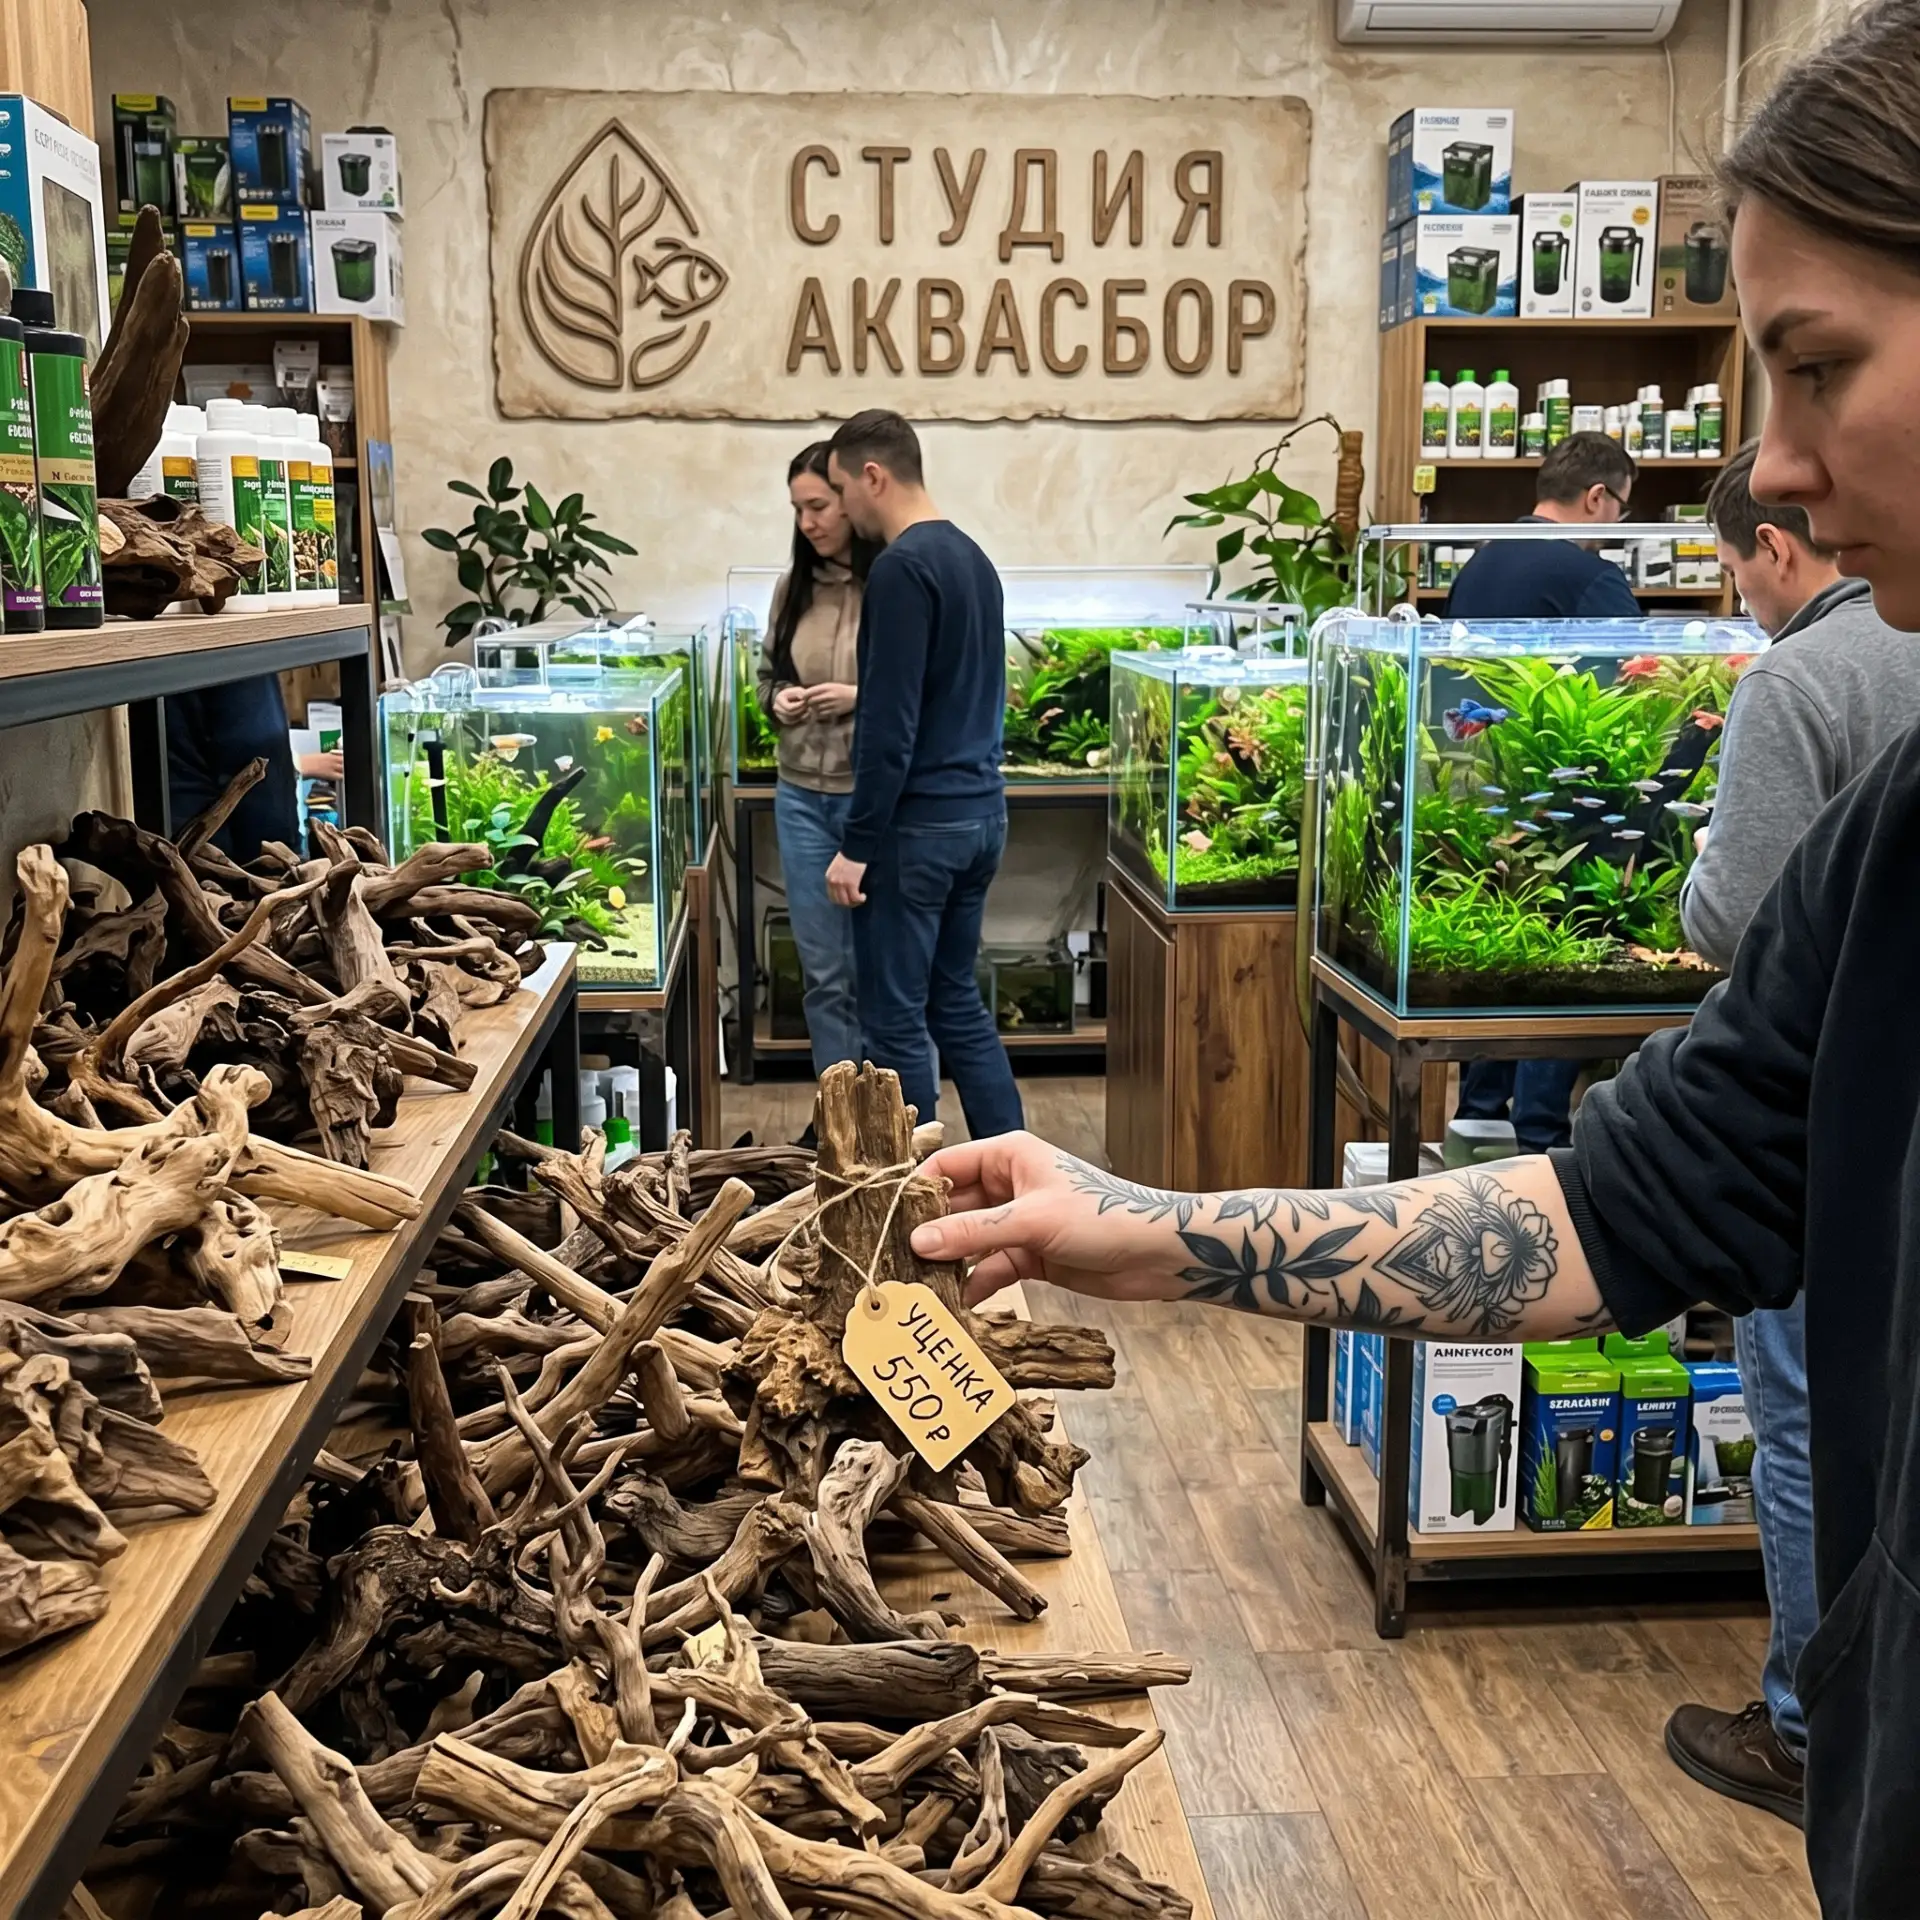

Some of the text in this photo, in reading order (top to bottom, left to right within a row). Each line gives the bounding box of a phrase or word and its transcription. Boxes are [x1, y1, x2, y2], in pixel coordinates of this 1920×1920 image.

[788, 144, 1223, 262] СТУДИЯ
[786, 277, 1277, 373] АКВАСБОР
[897, 1302, 995, 1413] УЦЕНКА
